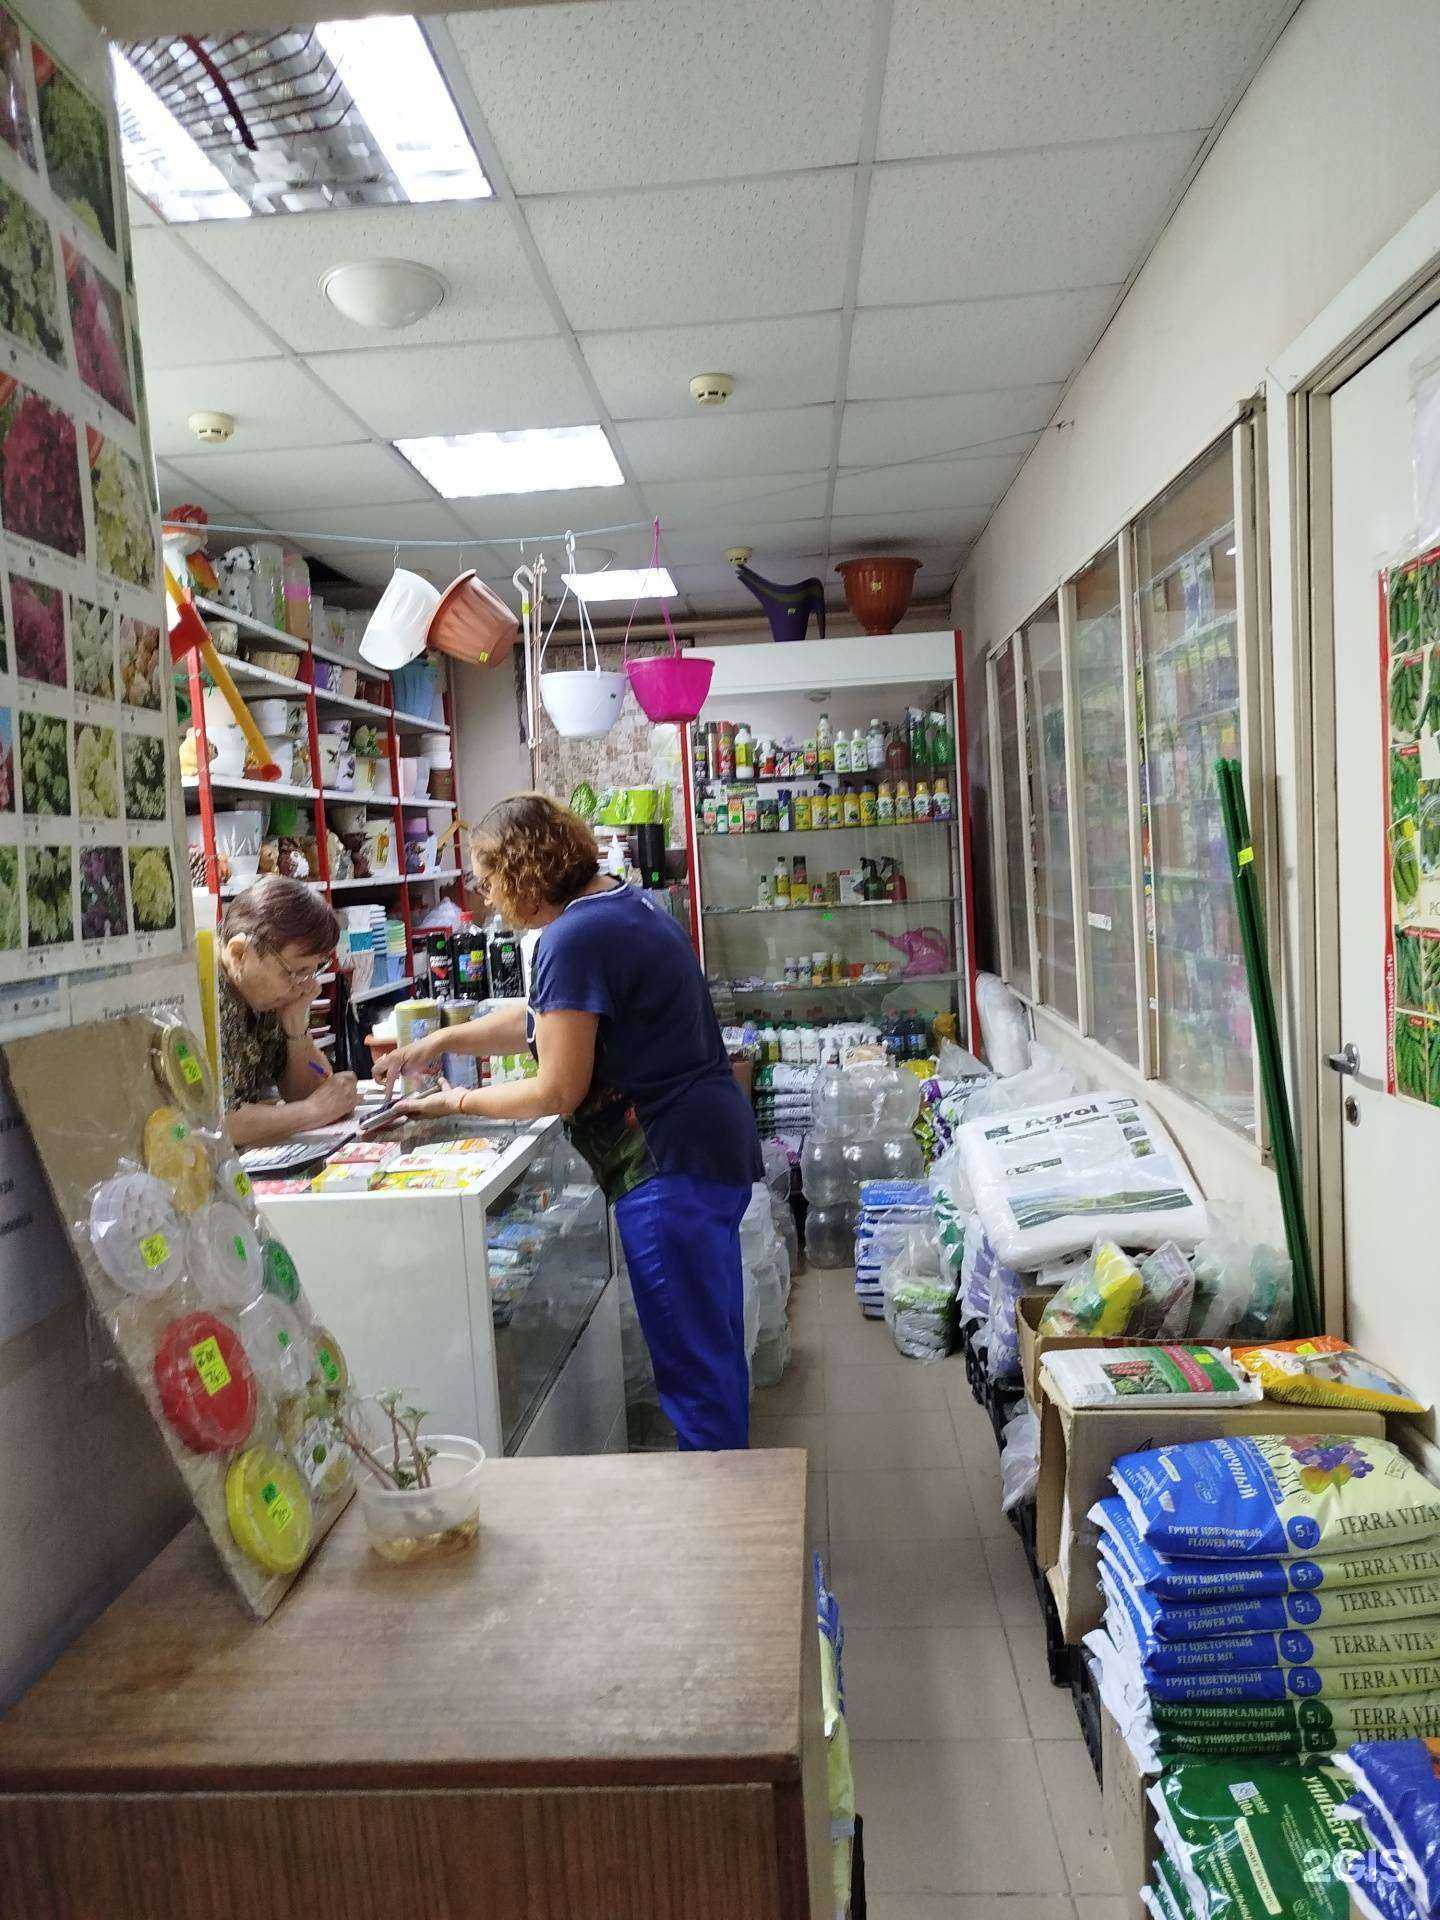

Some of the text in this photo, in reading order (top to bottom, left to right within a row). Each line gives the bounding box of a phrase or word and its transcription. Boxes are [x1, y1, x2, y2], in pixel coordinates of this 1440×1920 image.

[1336, 1511, 1397, 1535] TERRA
[1339, 1557, 1399, 1579] TERRA
[1336, 1589, 1396, 1612] TERRA
[1330, 1633, 1391, 1654] TERRA
[1339, 1670, 1399, 1690] TERRA
[1350, 1706, 1410, 1725] TERRA
[1353, 1727, 1409, 1742] TERRA
